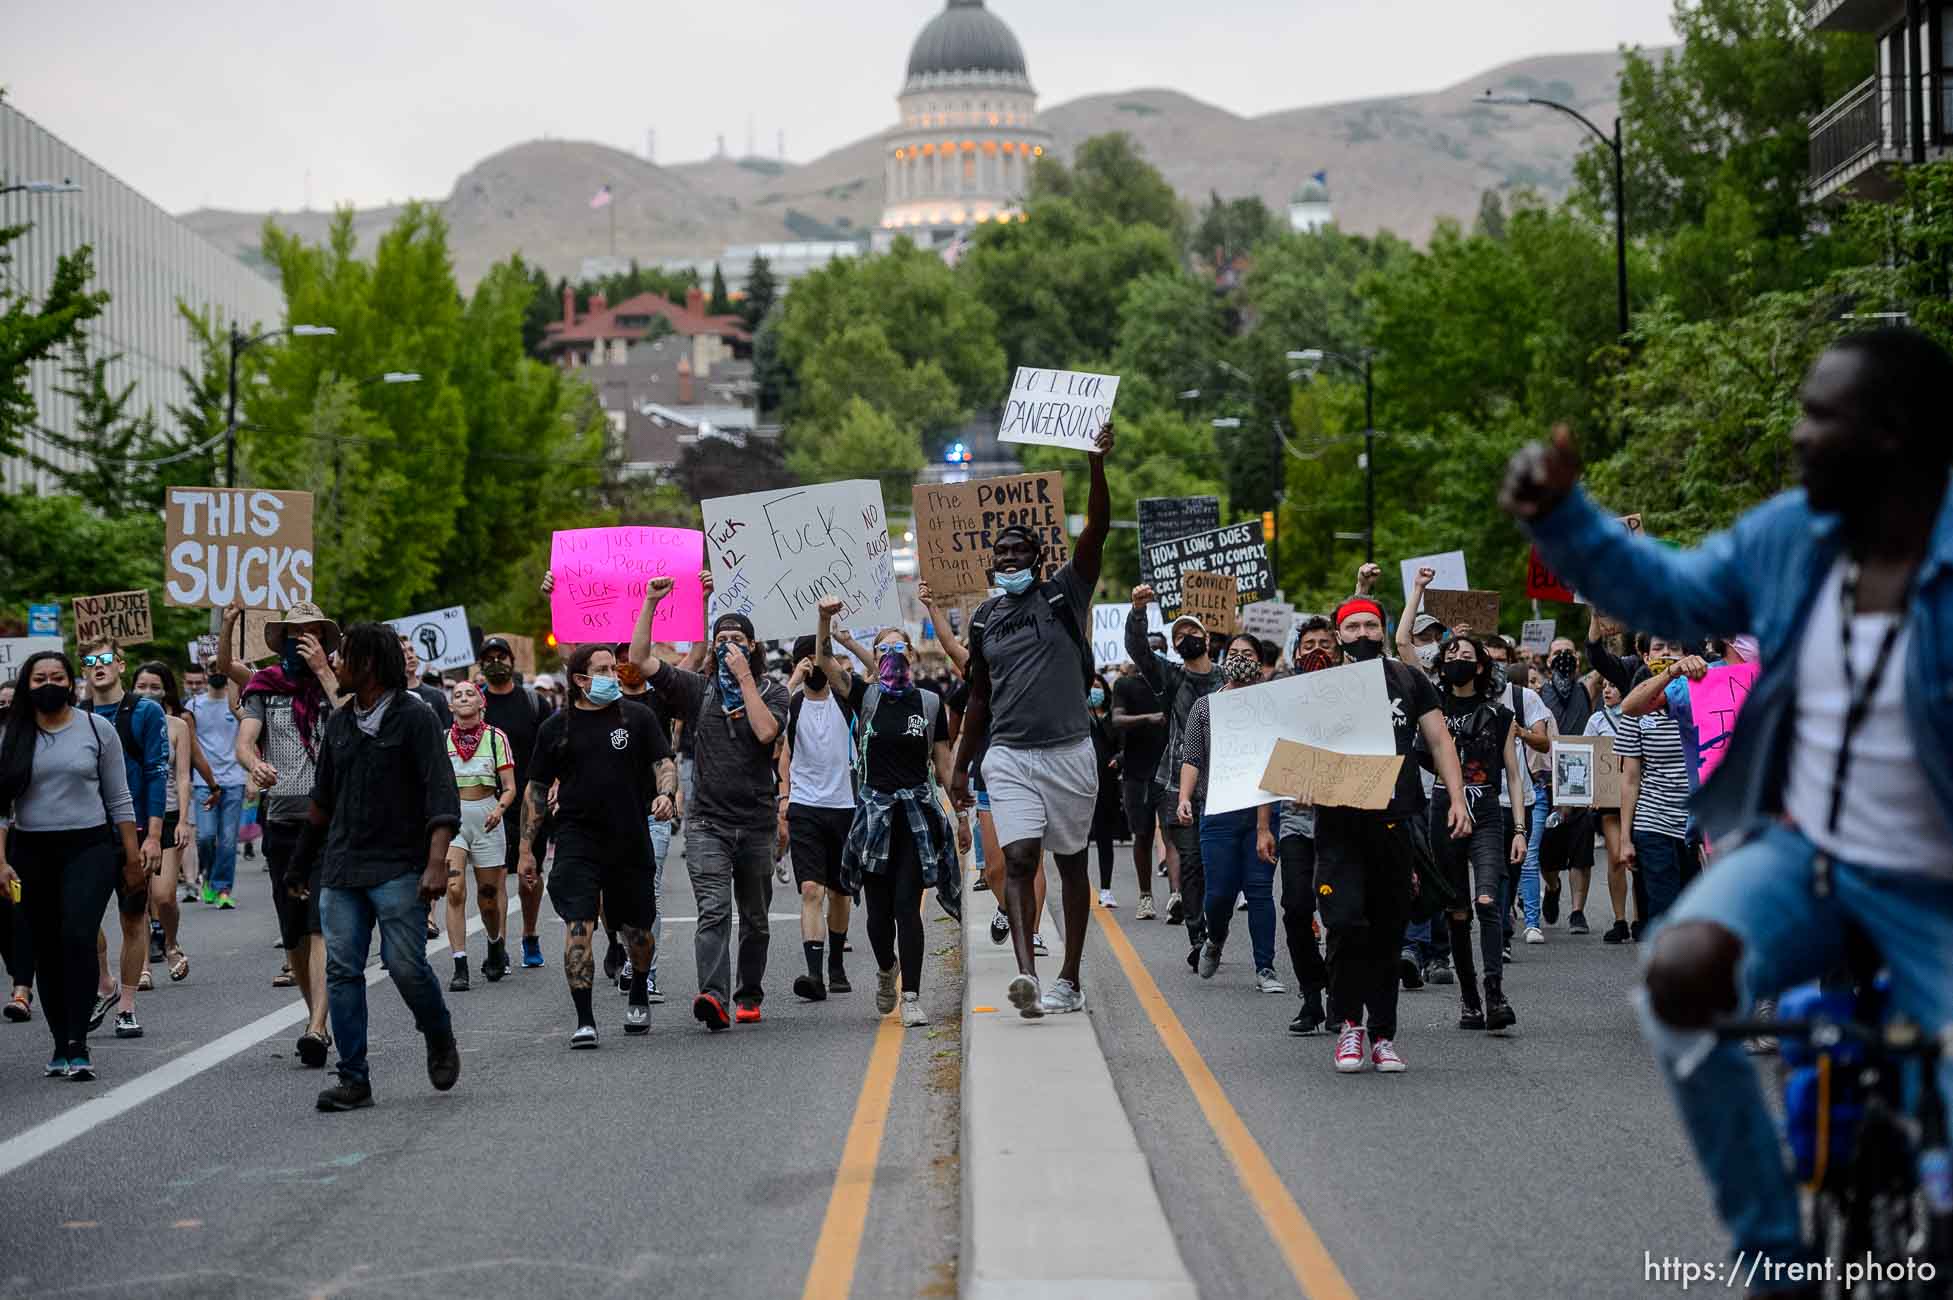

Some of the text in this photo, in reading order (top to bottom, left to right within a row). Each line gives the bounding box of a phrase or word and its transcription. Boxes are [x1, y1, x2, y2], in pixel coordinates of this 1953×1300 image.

[1016, 369, 1105, 399] DO I LOOK
[928, 478, 1051, 512] The POWER
[171, 490, 285, 537] THIS
[862, 504, 878, 529] NO
[952, 514, 976, 530] the
[982, 505, 1056, 530] PEOPLE
[560, 535, 588, 553] No
[952, 526, 1063, 552] STRER
[1150, 526, 1251, 566] HOW LONG DOES
[563, 559, 593, 580] No
[721, 549, 746, 569] 12
[1153, 564, 1177, 579] ONE
[1179, 557, 1207, 575] HAVE
[1210, 553, 1224, 567] TO
[167, 540, 313, 611] SUCKS
[1156, 579, 1177, 594] CRY
[1236, 561, 1258, 577] AND
[1186, 575, 1233, 591] CONVICT
[1161, 592, 1183, 609] ASK
[1236, 570, 1268, 593] RCY?
[1186, 592, 1229, 609] KILLER
[75, 598, 99, 619] NO
[100, 593, 148, 613] JUSTICE
[1096, 608, 1121, 630] NO
[1187, 610, 1225, 627] OPS!
[78, 610, 148, 640] NO PEACE!
[1093, 640, 1118, 662] NO
